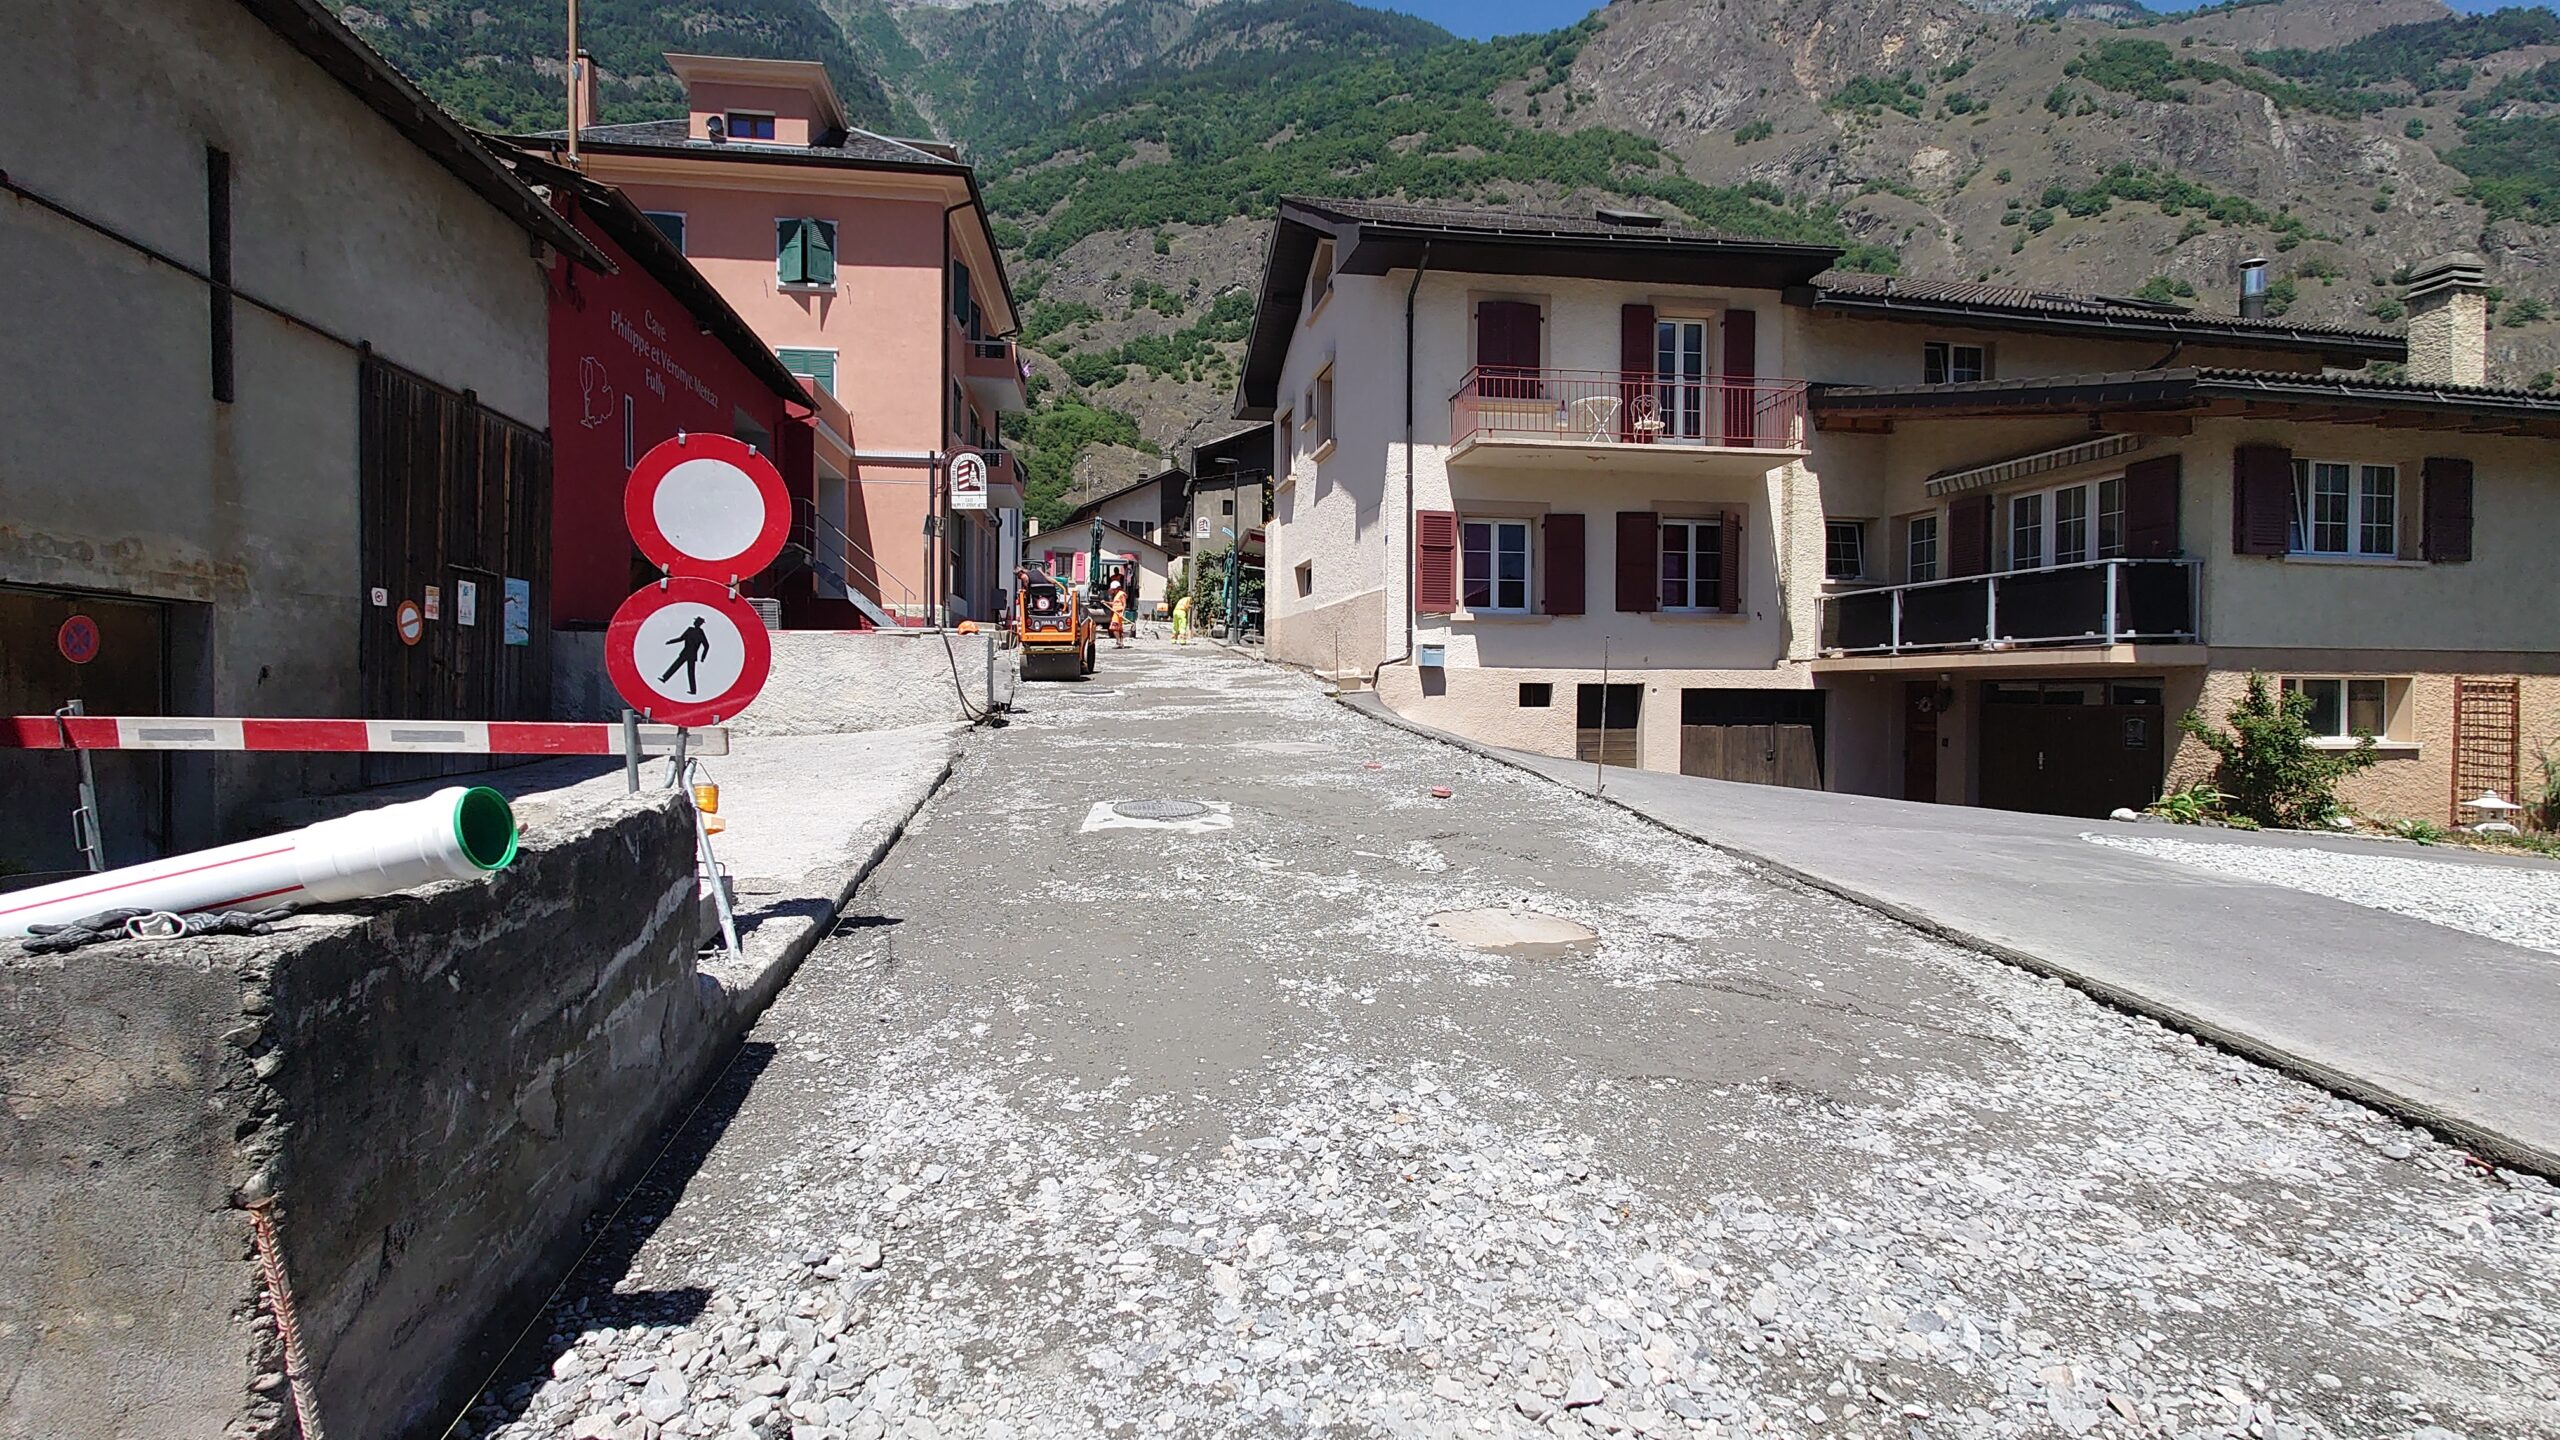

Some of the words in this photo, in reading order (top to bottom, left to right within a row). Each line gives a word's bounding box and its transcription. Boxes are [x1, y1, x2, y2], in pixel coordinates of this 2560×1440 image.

[611, 310, 650, 358] Philippe
[651, 346, 661, 365] et
[645, 309, 668, 342] Cave
[645, 367, 666, 403] Fully
